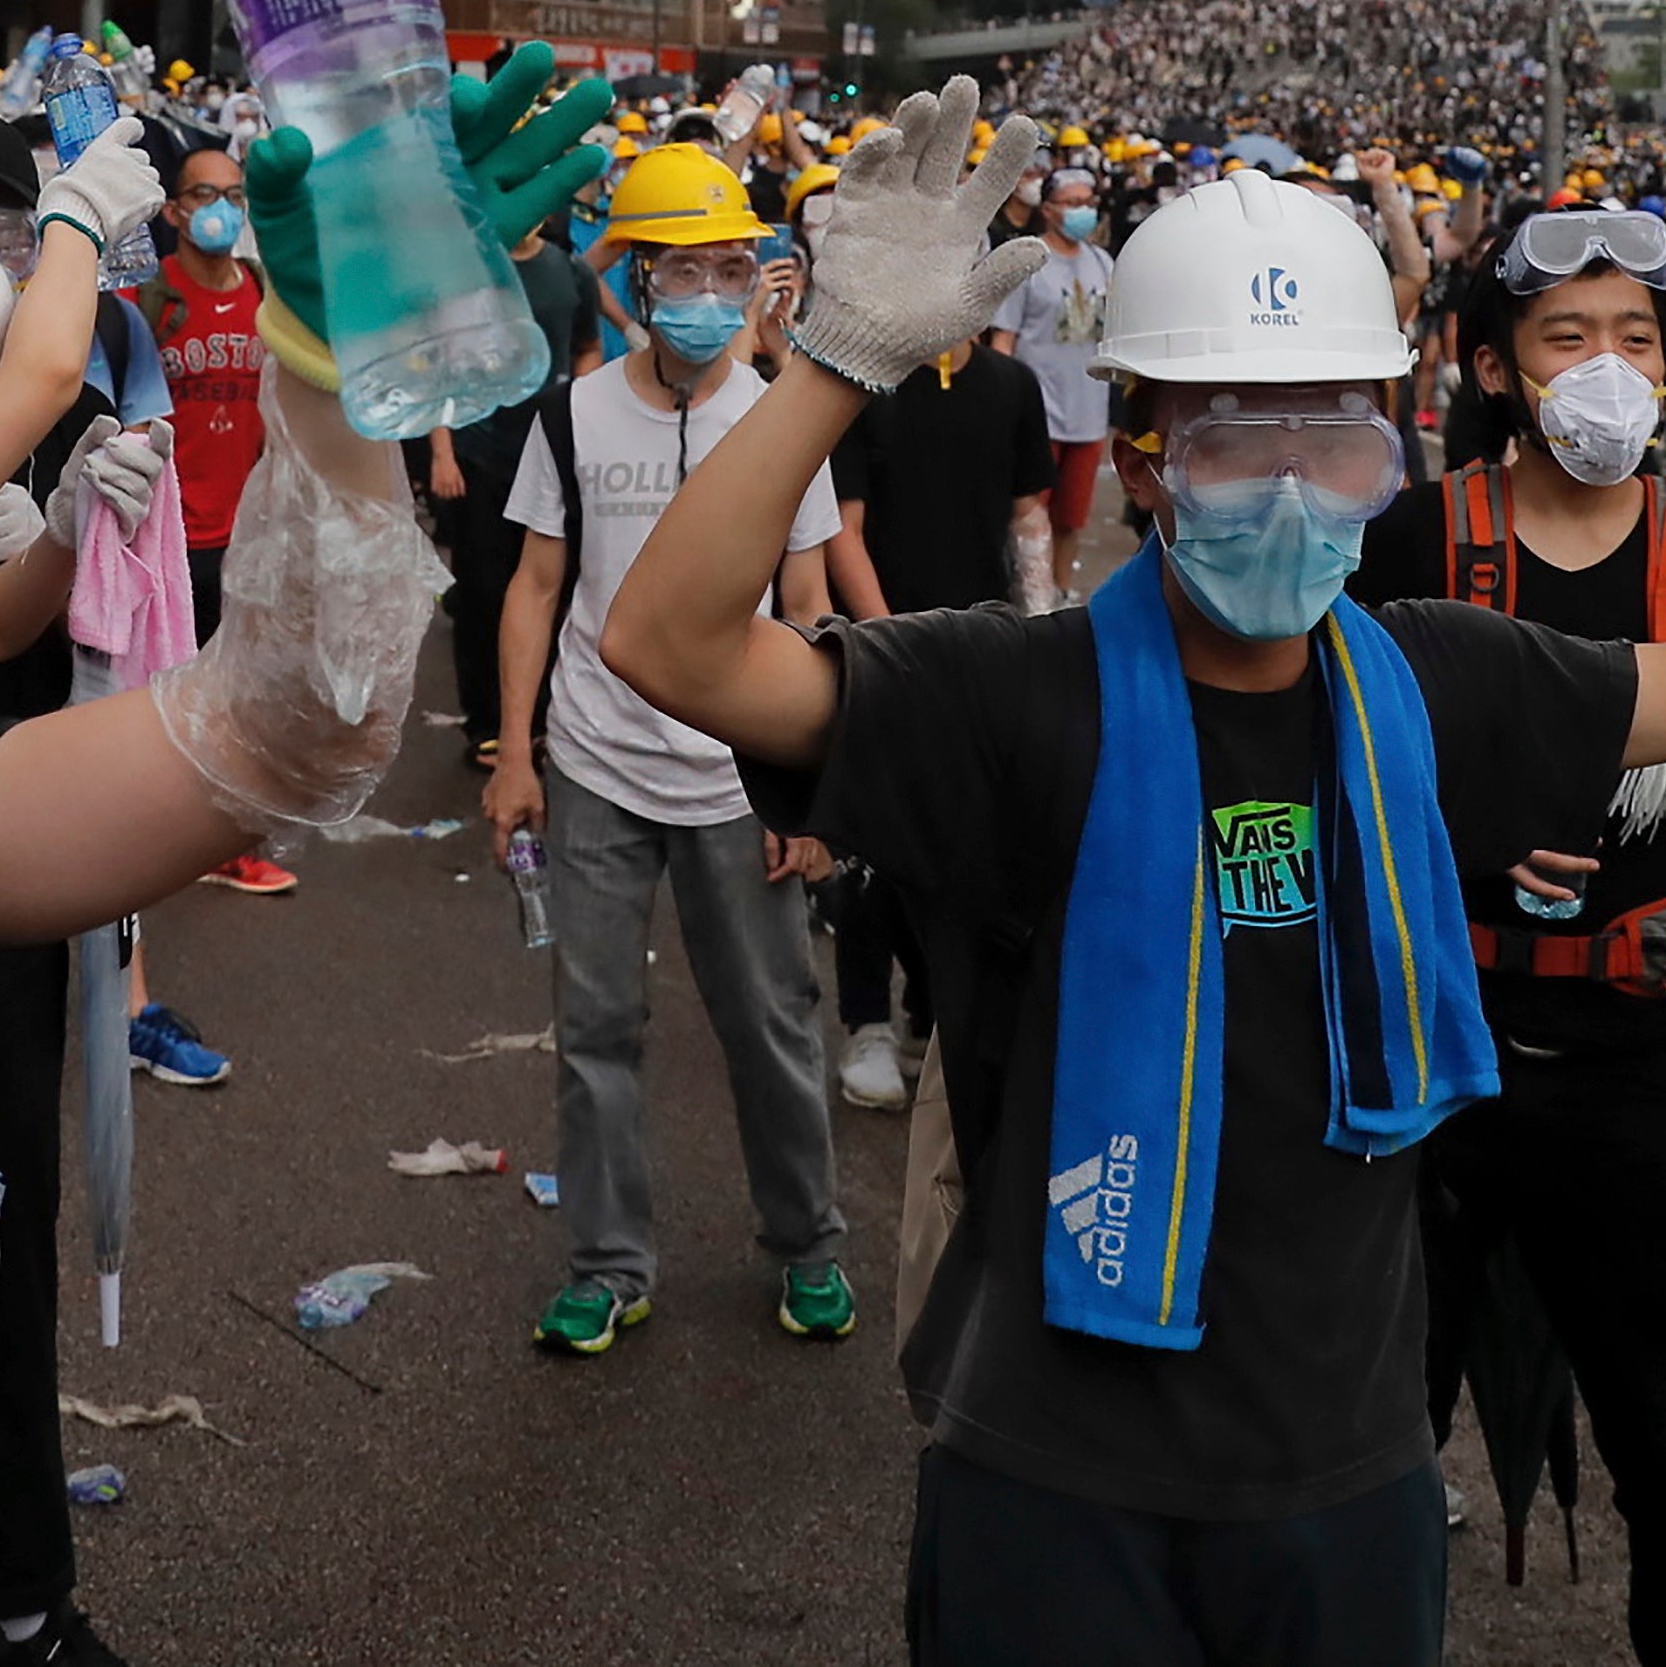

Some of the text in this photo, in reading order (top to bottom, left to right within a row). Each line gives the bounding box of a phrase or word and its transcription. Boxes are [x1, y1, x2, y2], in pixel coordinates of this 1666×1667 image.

[1249, 312, 1300, 327] KOREL
[1222, 857, 1294, 912] THE
[1096, 1134, 1139, 1288] adidas
